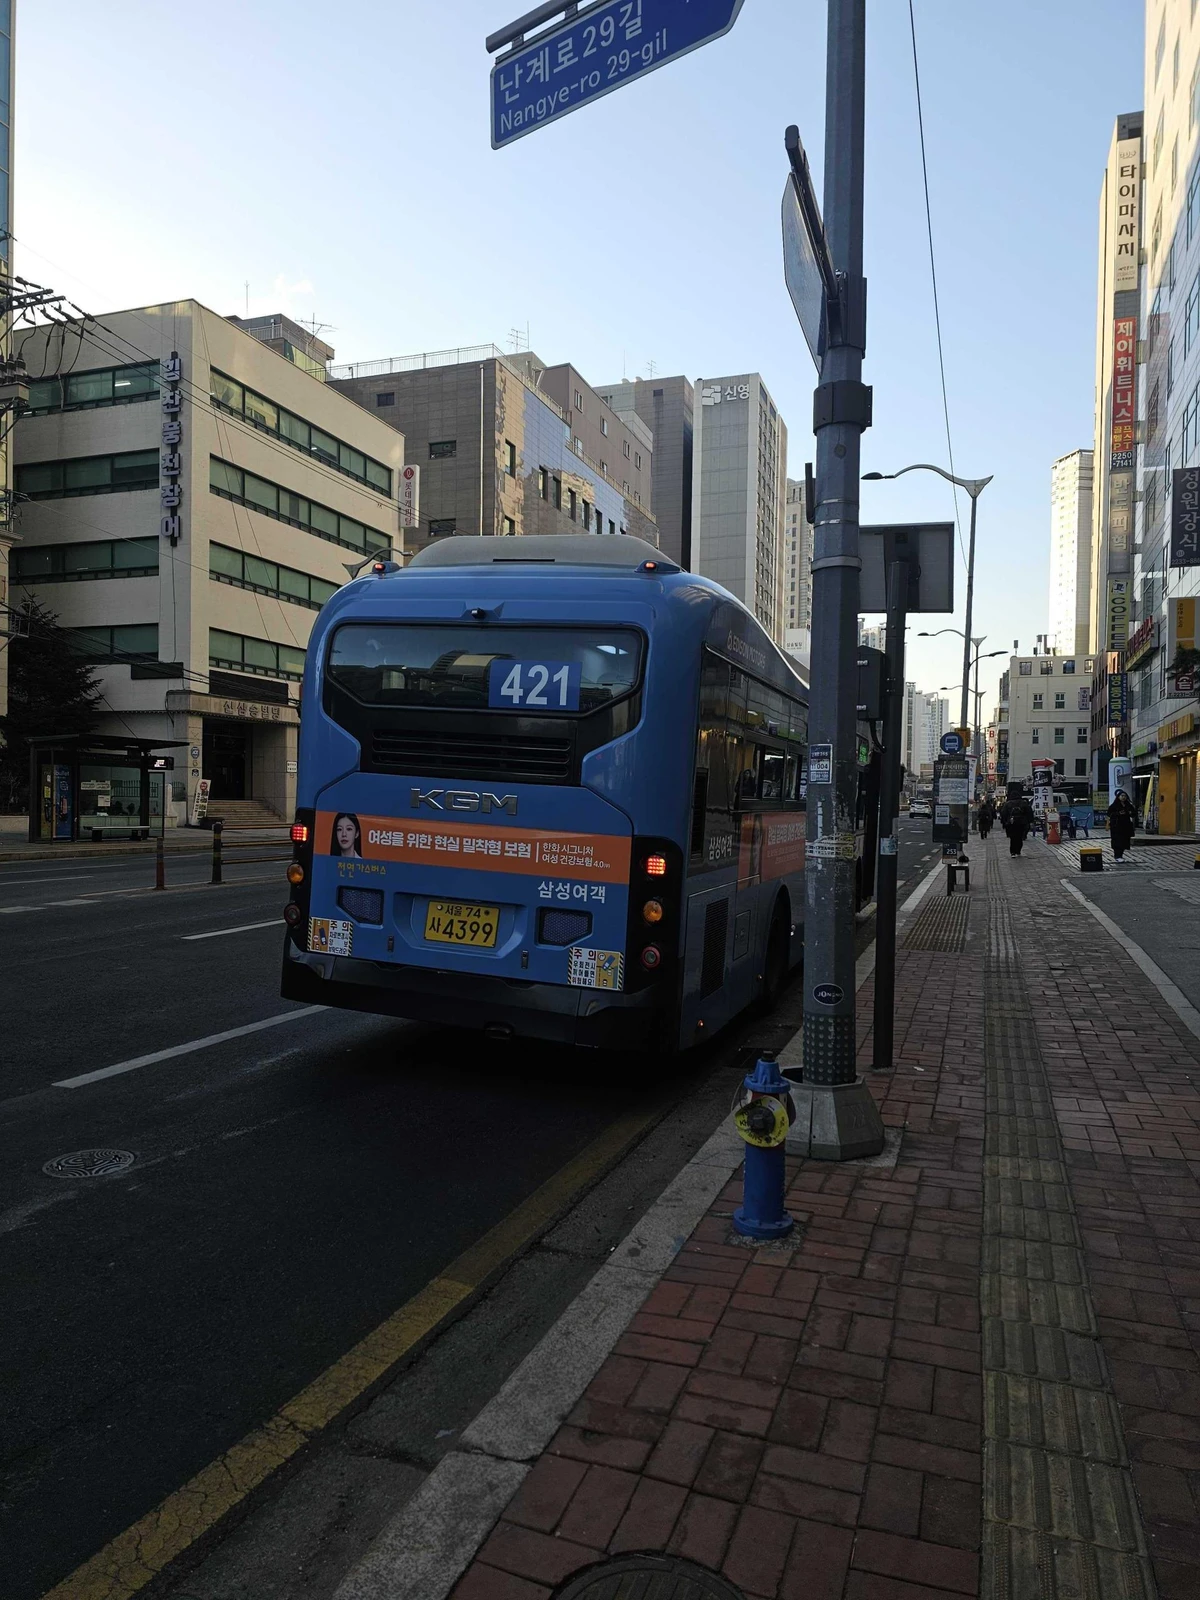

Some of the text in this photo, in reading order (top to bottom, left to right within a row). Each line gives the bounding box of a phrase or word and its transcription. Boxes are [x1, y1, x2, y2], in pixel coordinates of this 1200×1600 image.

[500, 28, 668, 134] Nangye-ro 29-gil
[1117, 164, 1137, 256] 타이마사지
[1115, 321, 1133, 424] 제이휘트니스
[724, 384, 750, 401] 신영
[1112, 452, 1132, 460] 2250
[1179, 470, 1200, 551] 성원장식
[1110, 597, 1127, 650] COFFEE
[500, 663, 570, 706] 421
[410, 788, 518, 815] KGM
[368, 829, 531, 858] 여성을 위한 현실 밀착형 보험
[542, 842, 594, 857] 한화 시그니처
[542, 853, 558, 864] 여성
[560, 855, 593, 868] 건강보험
[538, 881, 606, 904] 삼성여객
[445, 904, 482, 919] 서울 74
